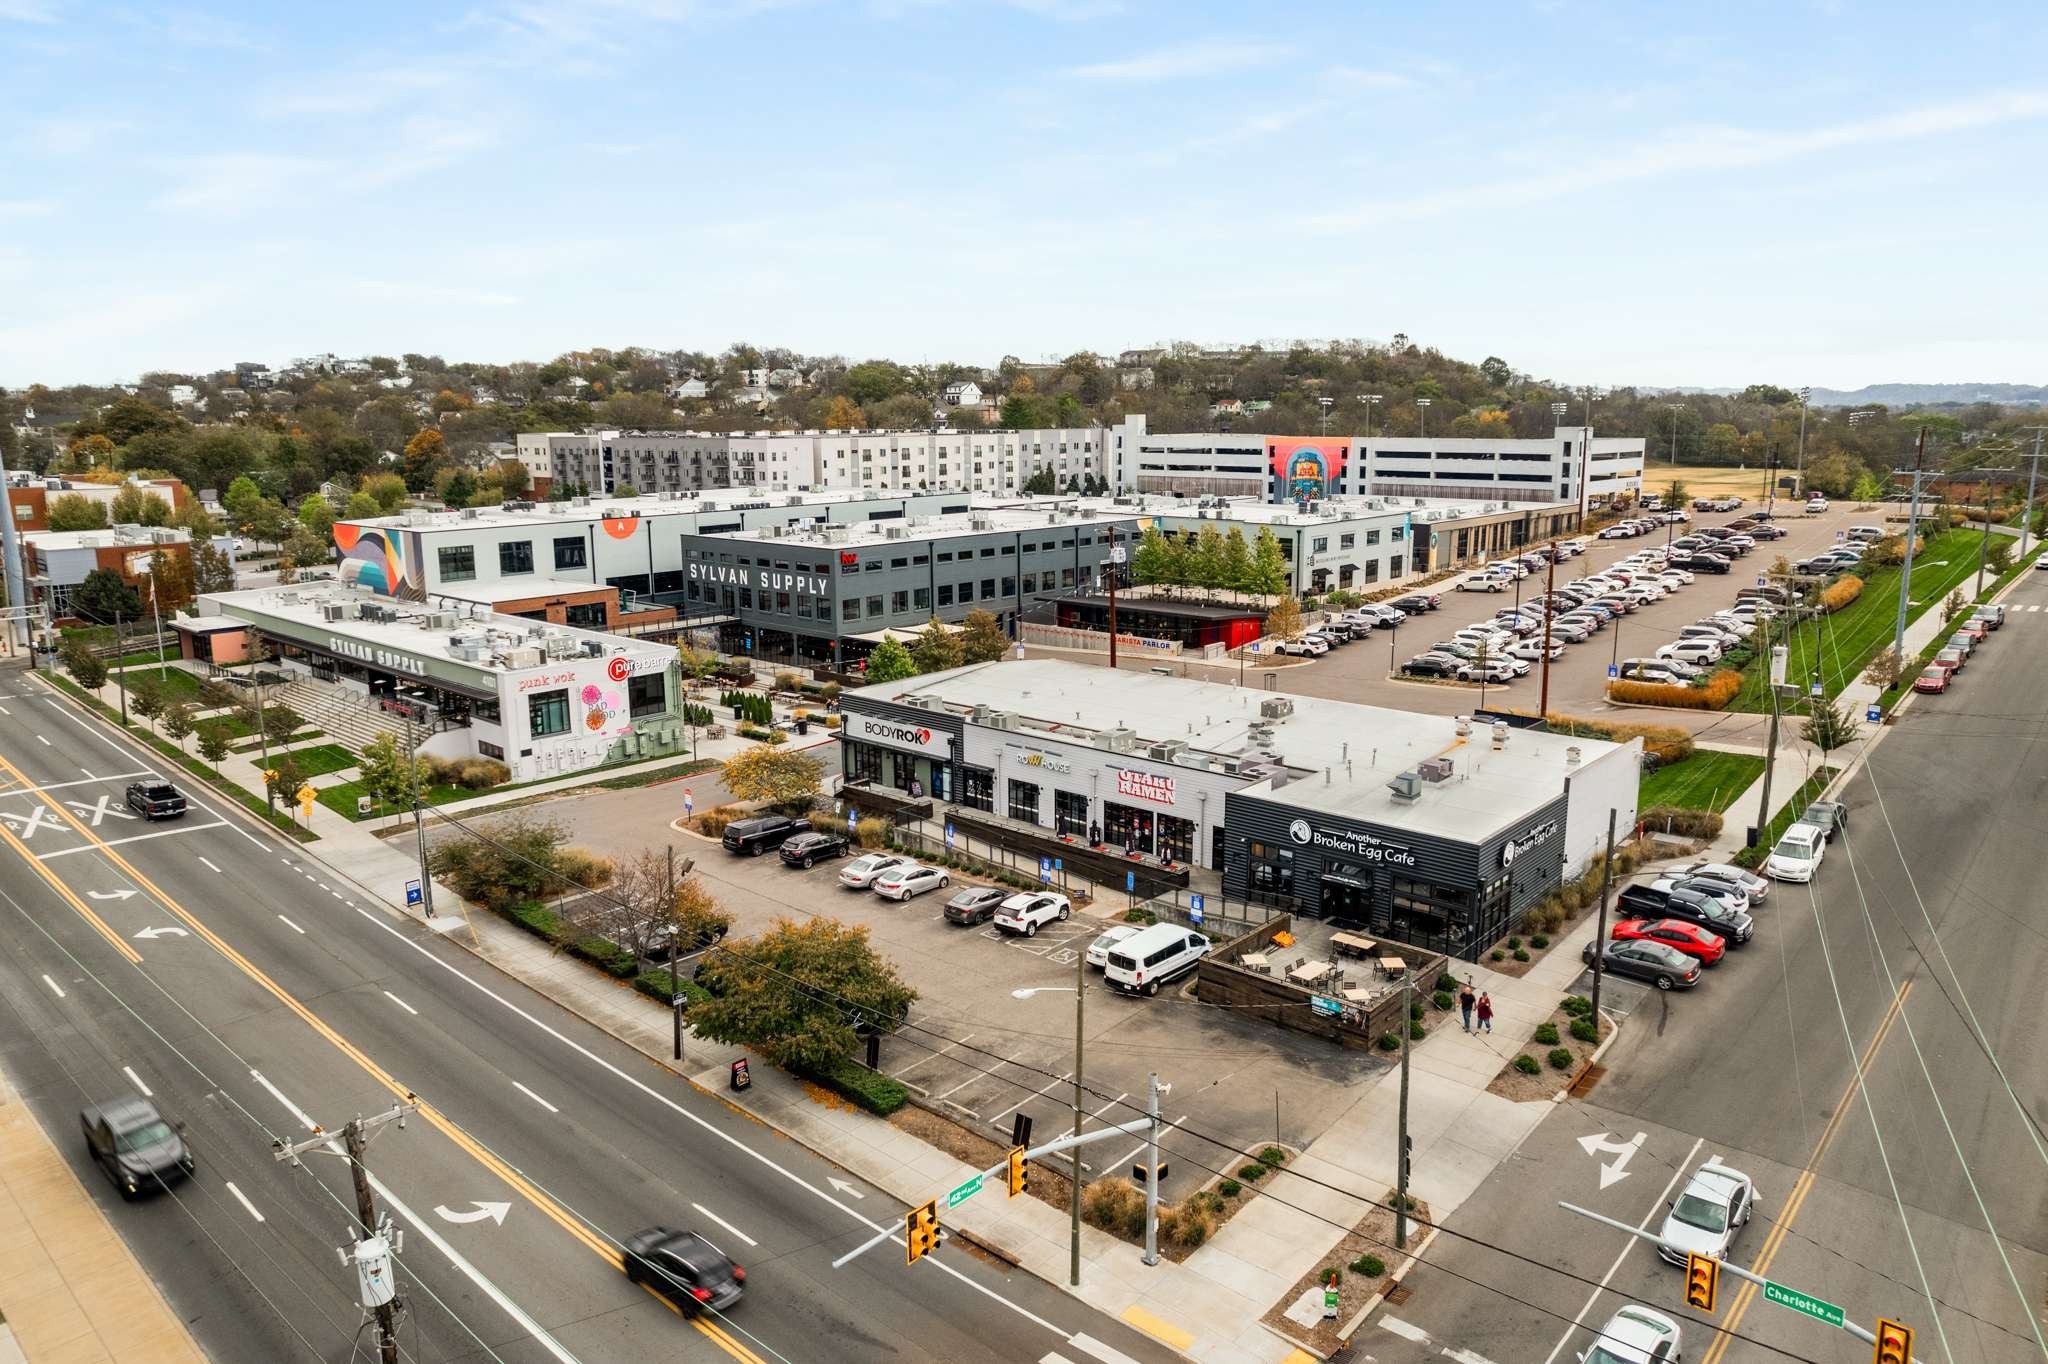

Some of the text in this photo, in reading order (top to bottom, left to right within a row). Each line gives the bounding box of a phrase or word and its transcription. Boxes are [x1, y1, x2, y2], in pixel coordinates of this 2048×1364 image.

[617, 521, 625, 531] A
[690, 563, 828, 596] SYLVAN SUPPLY
[1115, 635, 1171, 650] ARISTA PARLOR
[330, 637, 425, 676] SYLVAN SUPPLY
[865, 722, 926, 746] BODYROK
[1042, 760, 1071, 775] HOUSE
[1118, 768, 1176, 791] OTAKU
[1118, 780, 1176, 805] RAMEN
[1313, 832, 1416, 866] Broken Egg Cafe
[1345, 830, 1382, 847] Another
[1766, 1286, 1842, 1323] Charlotte Ave
